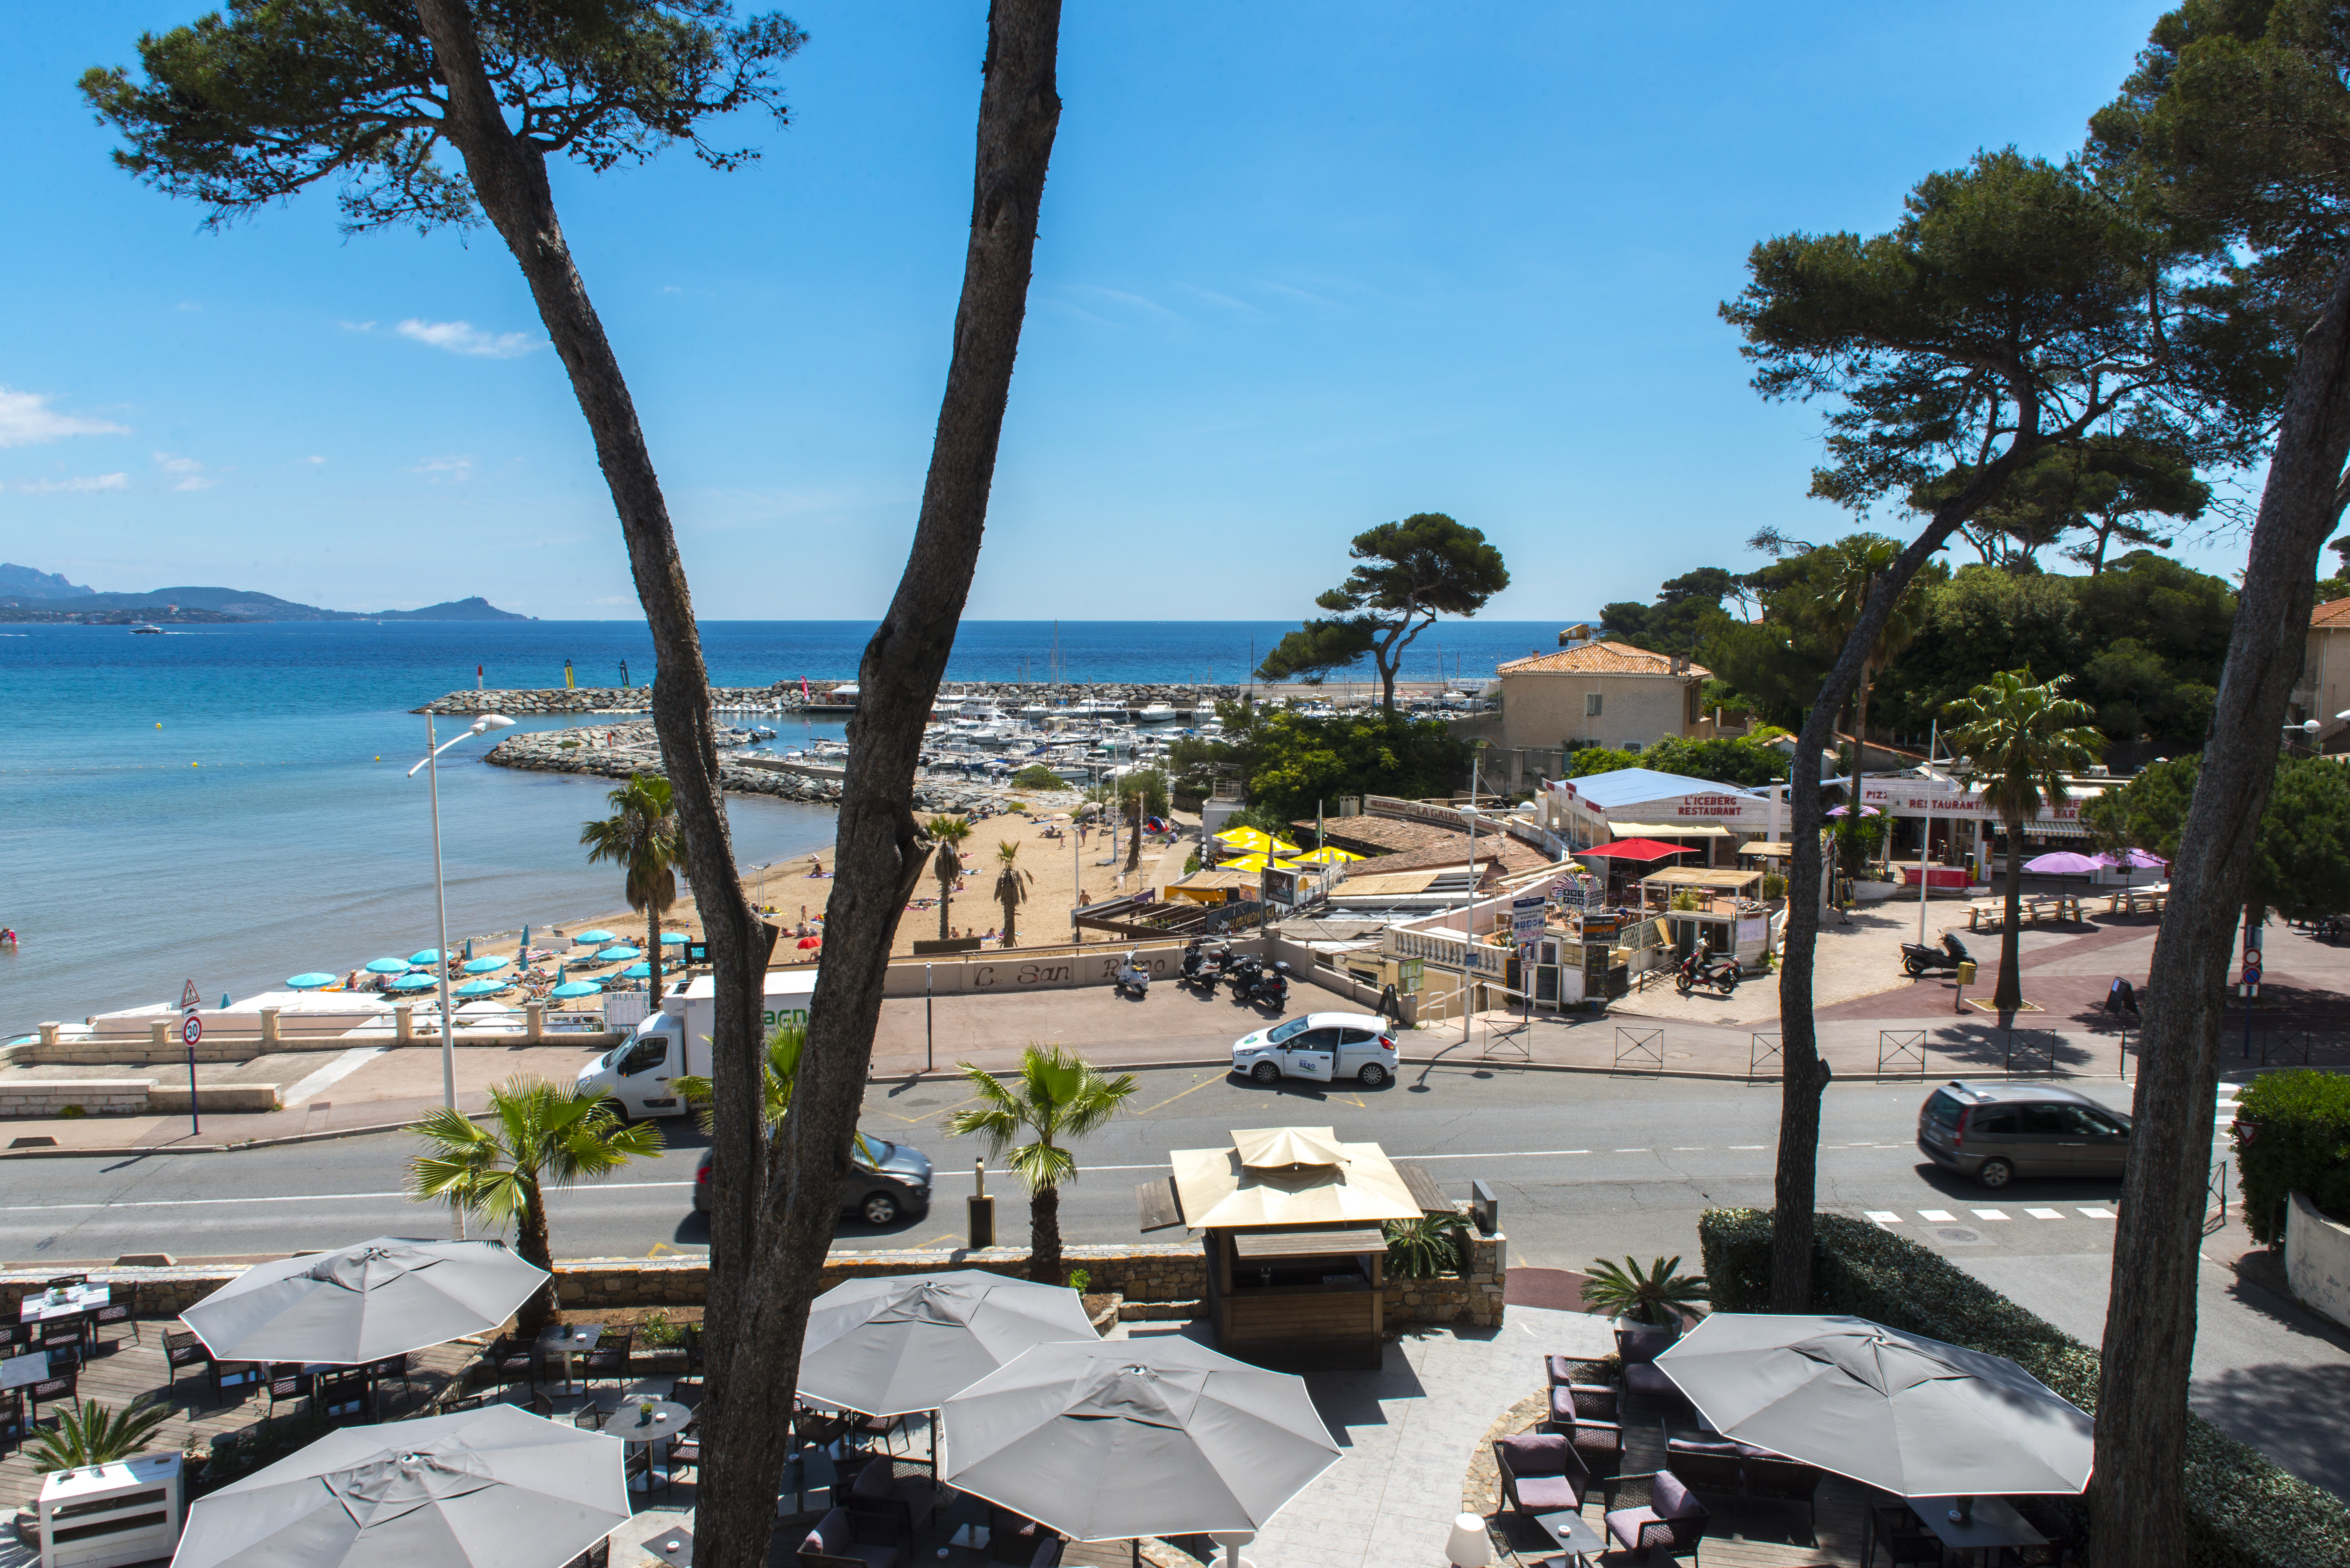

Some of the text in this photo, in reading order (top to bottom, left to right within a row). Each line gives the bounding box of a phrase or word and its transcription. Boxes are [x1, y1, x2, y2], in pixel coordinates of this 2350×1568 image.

[1685, 795, 1737, 805] L'ICEBERG
[1371, 798, 1406, 811] RESTAURANT
[1416, 806, 1429, 816] LA
[1678, 807, 1742, 815] RESTAURANT
[2053, 809, 2076, 819] BAR
[1268, 893, 1291, 903] RESTAURANT
[1584, 925, 1616, 933] BUNGALOW
[1017, 965, 1069, 984] San
[1102, 959, 1165, 978] Rmo
[187, 1024, 198, 1039] 30
